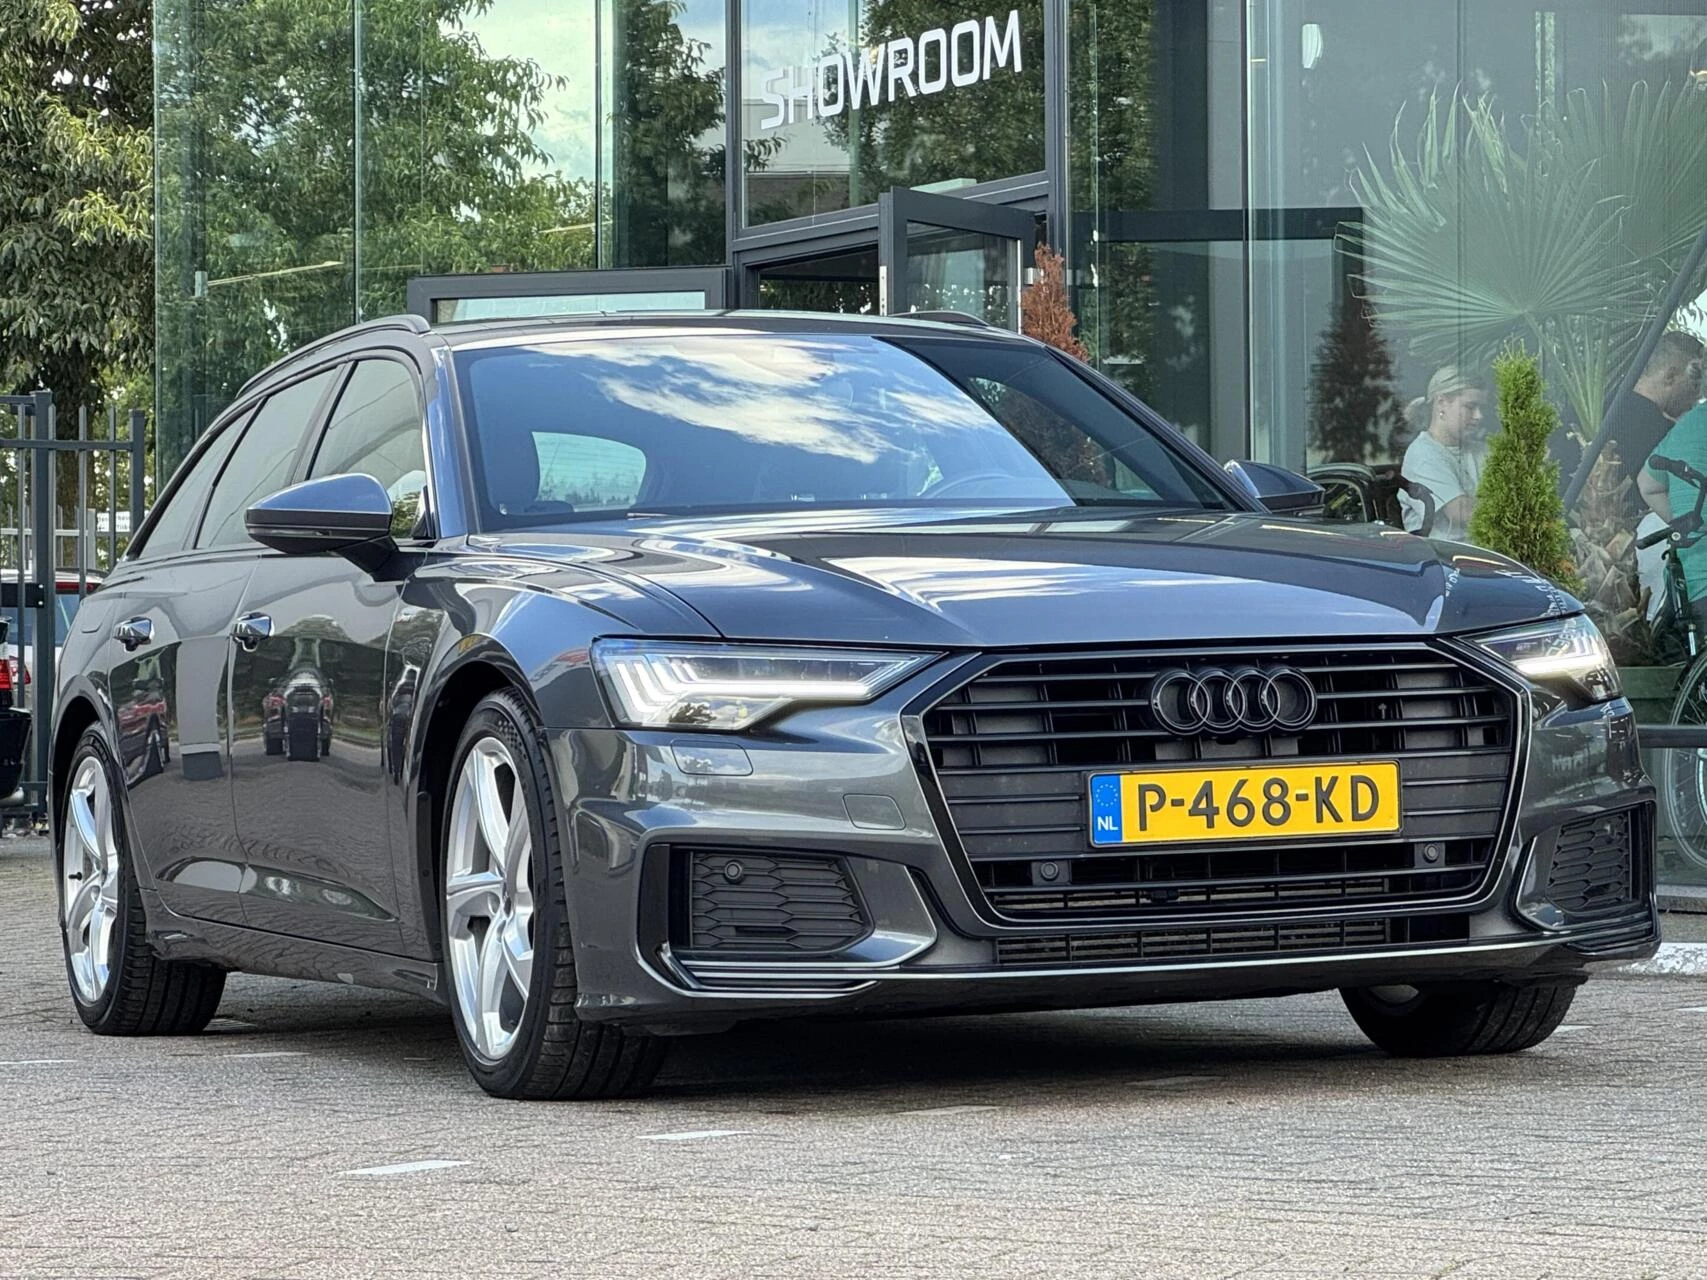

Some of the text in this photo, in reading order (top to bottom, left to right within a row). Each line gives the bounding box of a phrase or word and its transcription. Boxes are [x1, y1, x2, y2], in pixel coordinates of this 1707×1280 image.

[760, 9, 1023, 131] SHOWROOM
[1097, 815, 1119, 832] NL
[1137, 774, 1380, 832] P-468-KD
